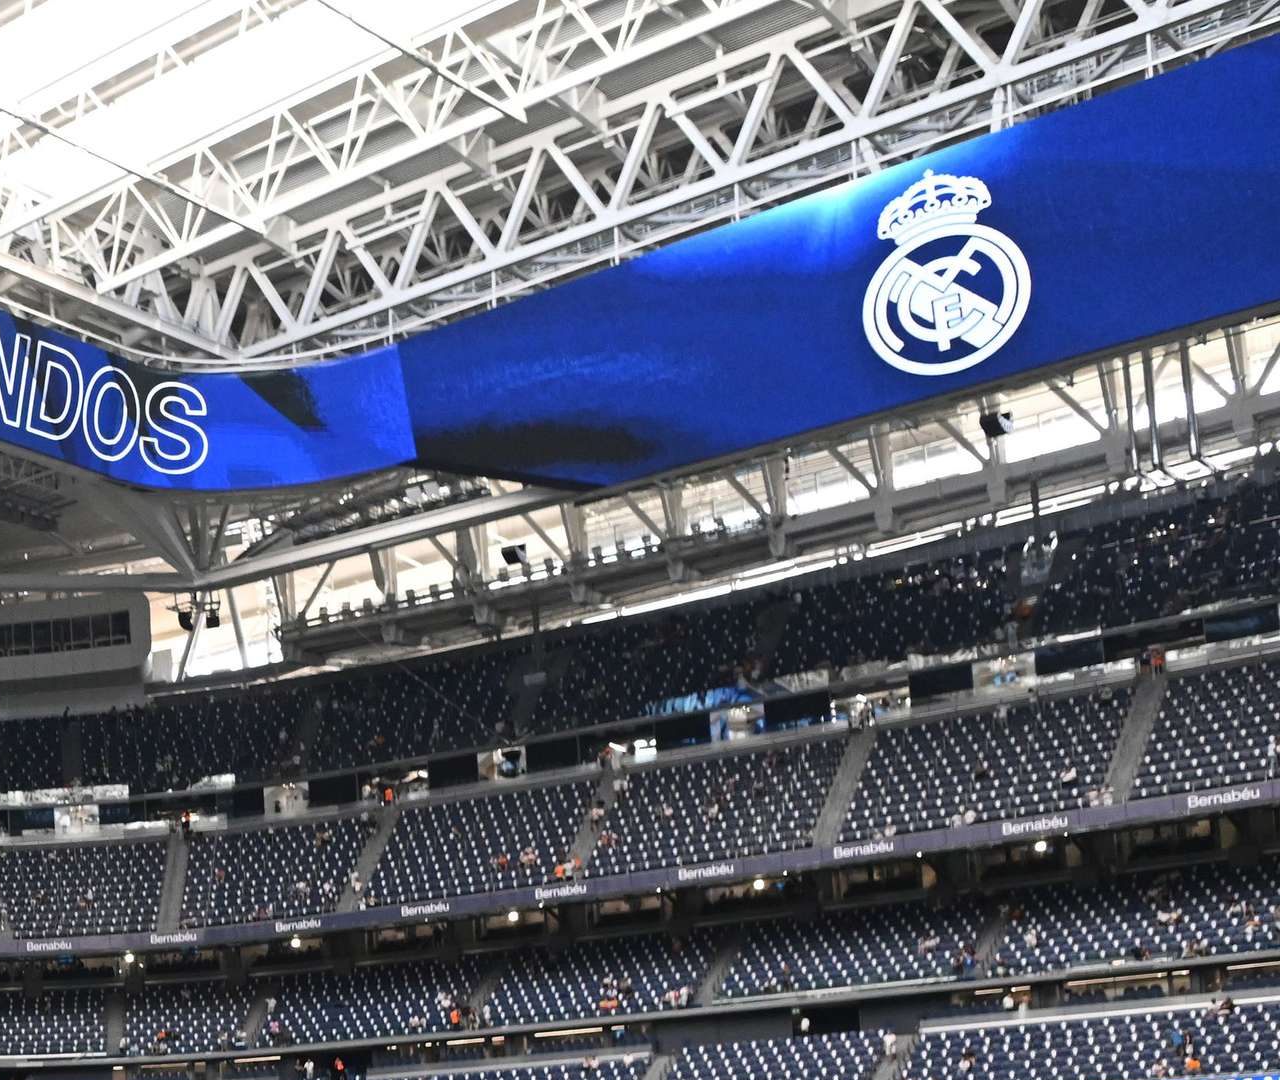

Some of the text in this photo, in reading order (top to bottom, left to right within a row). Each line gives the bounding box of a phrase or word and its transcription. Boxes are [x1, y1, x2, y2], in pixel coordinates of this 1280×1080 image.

[1187, 786, 1261, 809] Bernabéu
[1002, 815, 1068, 836] Bernabéu
[833, 840, 894, 860] Bernabéu
